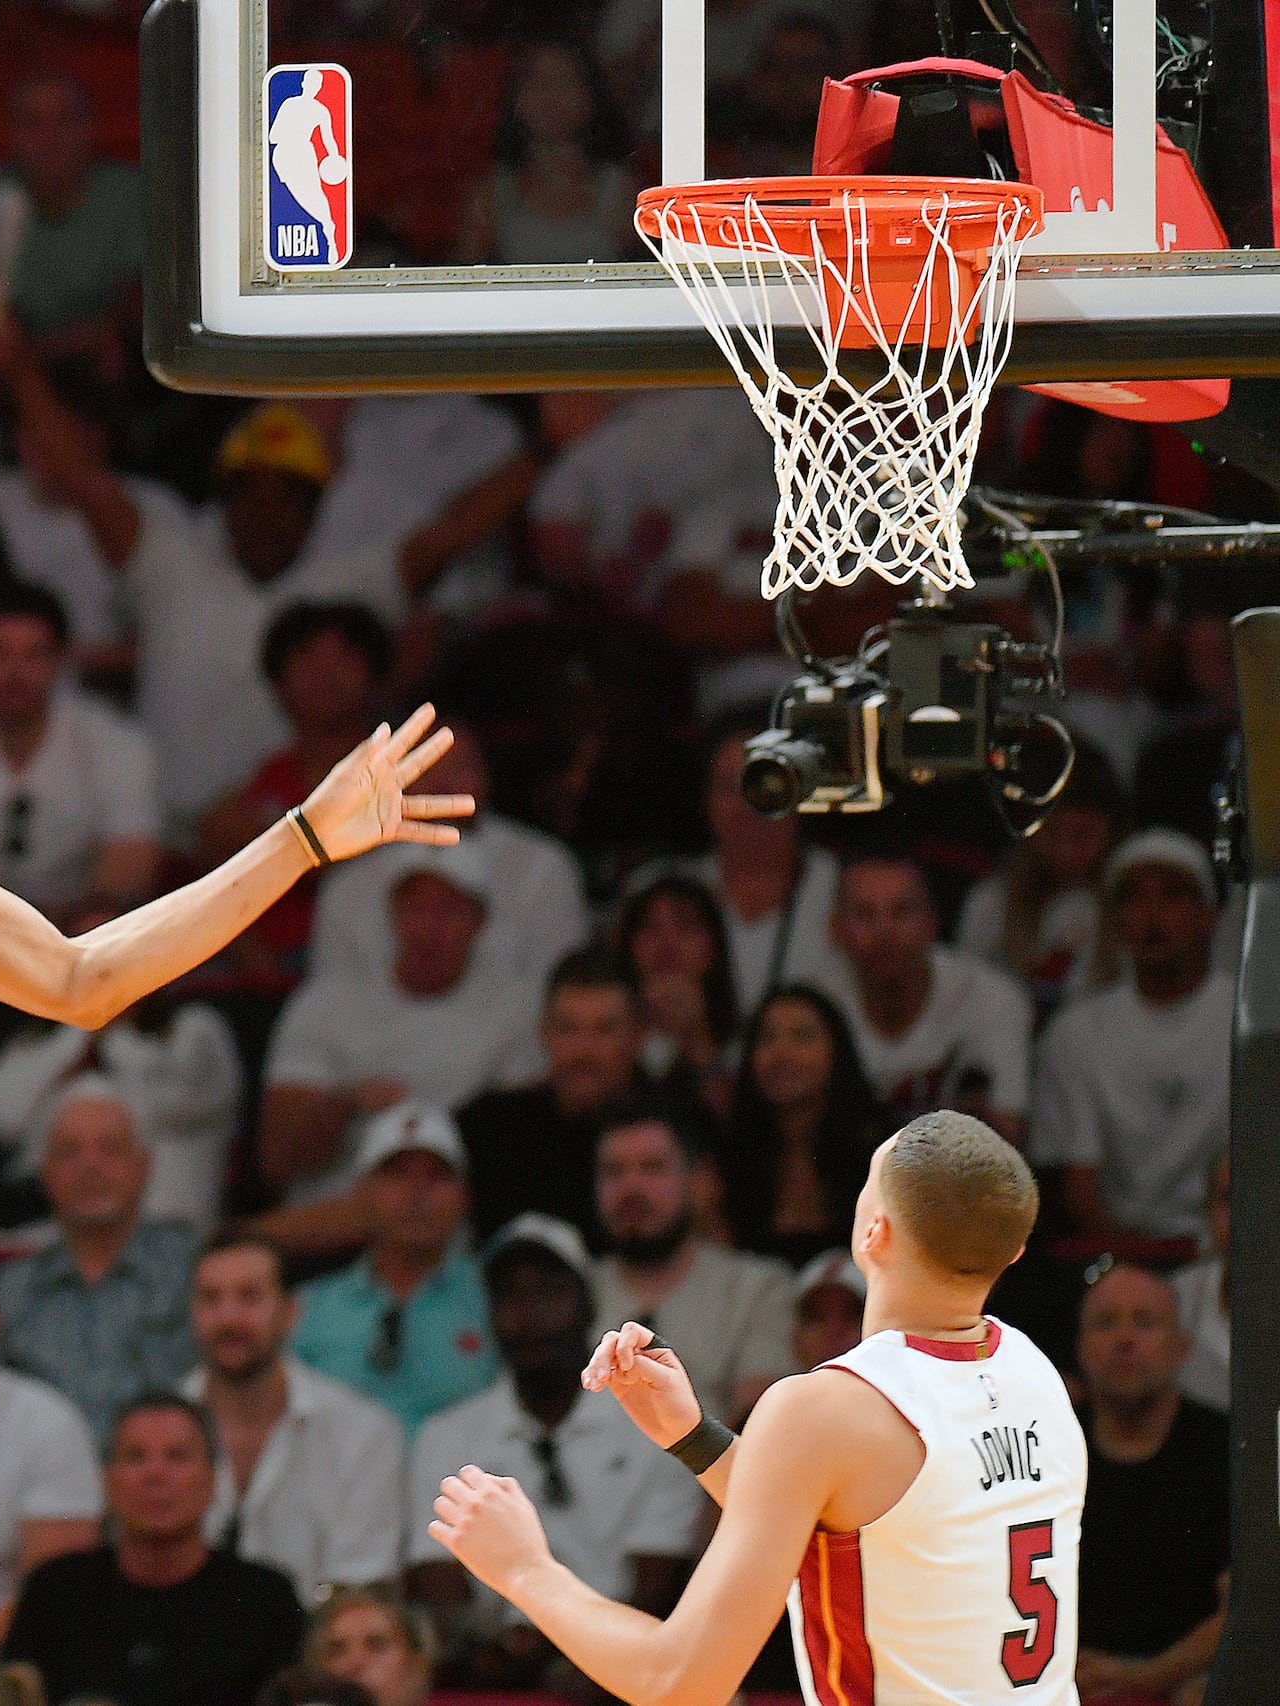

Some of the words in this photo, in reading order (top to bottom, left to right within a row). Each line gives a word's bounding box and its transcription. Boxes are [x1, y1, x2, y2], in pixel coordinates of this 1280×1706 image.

[277, 224, 320, 257] NBA
[970, 1419, 1041, 1491] JOVIĆ
[1001, 1517, 1058, 1688] 5
